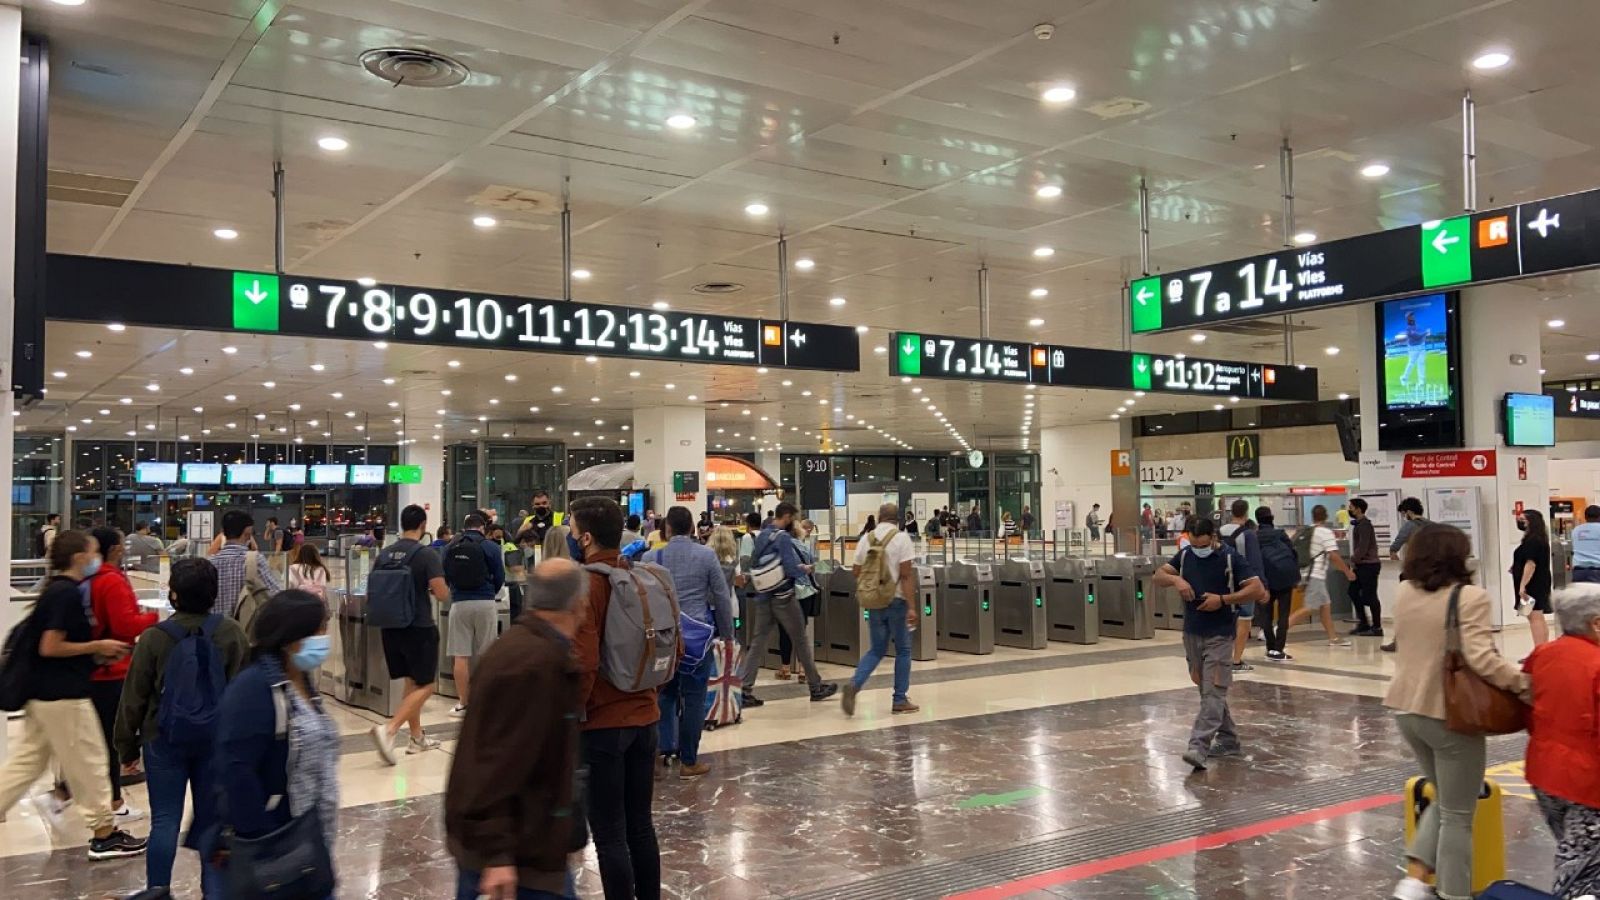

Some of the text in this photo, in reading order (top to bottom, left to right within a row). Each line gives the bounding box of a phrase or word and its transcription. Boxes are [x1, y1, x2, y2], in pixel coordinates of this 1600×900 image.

[1297, 251, 1326, 268] Vías
[1190, 258, 1294, 316] 7 a 14
[1297, 270, 1327, 287] Vies
[1298, 284, 1345, 301] PLATFORMS
[940, 340, 955, 371] 7
[956, 358, 967, 373] a
[970, 343, 1002, 375] 14
[1119, 453, 1130, 467] R
